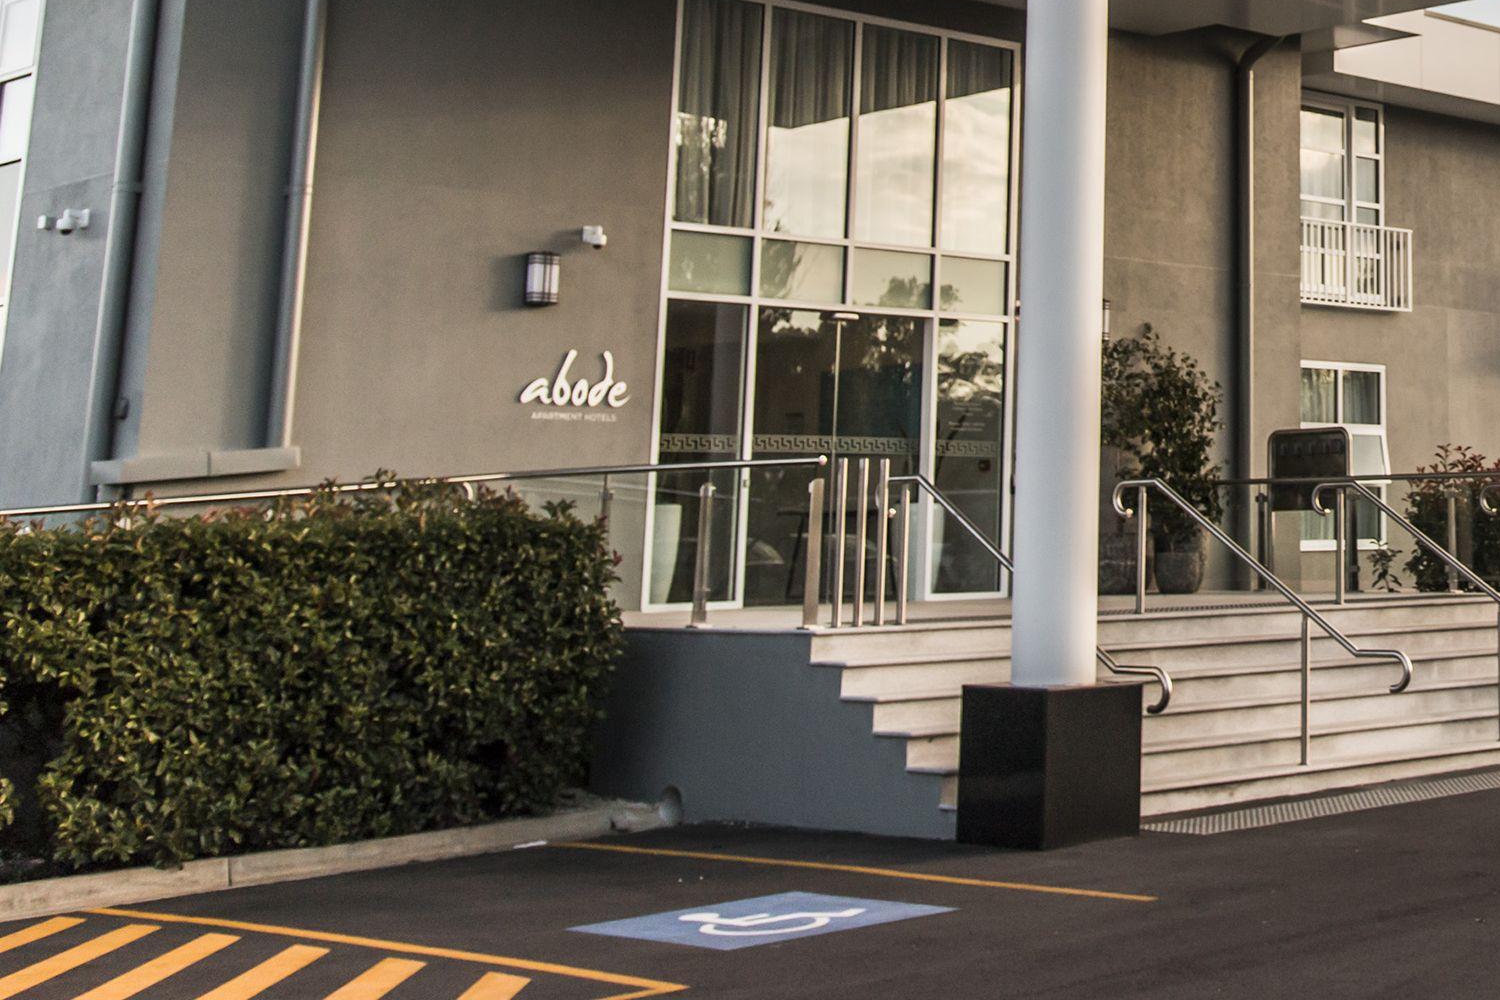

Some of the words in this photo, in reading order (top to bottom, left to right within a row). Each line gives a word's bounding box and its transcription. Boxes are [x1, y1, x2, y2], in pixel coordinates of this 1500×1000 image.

[520, 349, 631, 407] abode
[531, 412, 583, 421] APARTMENT
[584, 413, 617, 422] HOTELS
